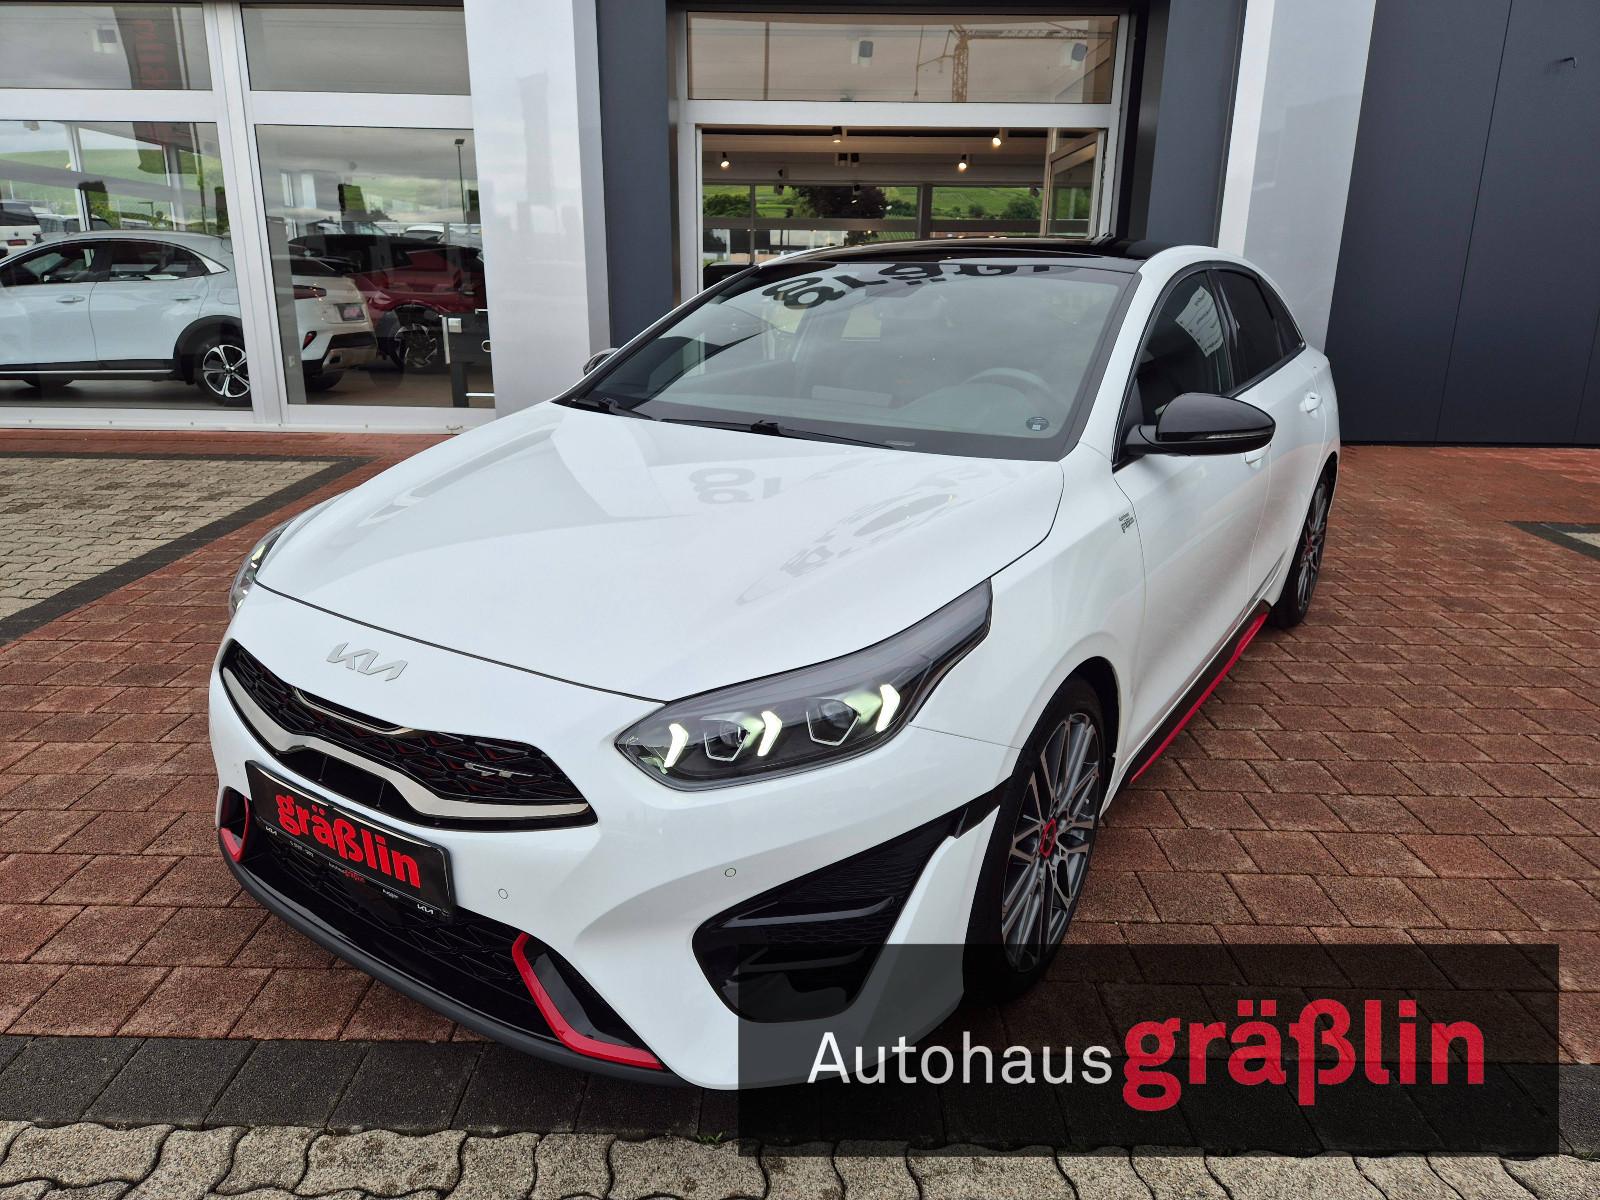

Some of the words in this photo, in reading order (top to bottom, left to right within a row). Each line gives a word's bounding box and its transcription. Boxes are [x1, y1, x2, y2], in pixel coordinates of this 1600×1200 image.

[326, 642, 408, 682] KIA
[275, 794, 421, 889] gräßlin
[416, 903, 434, 915] KIA
